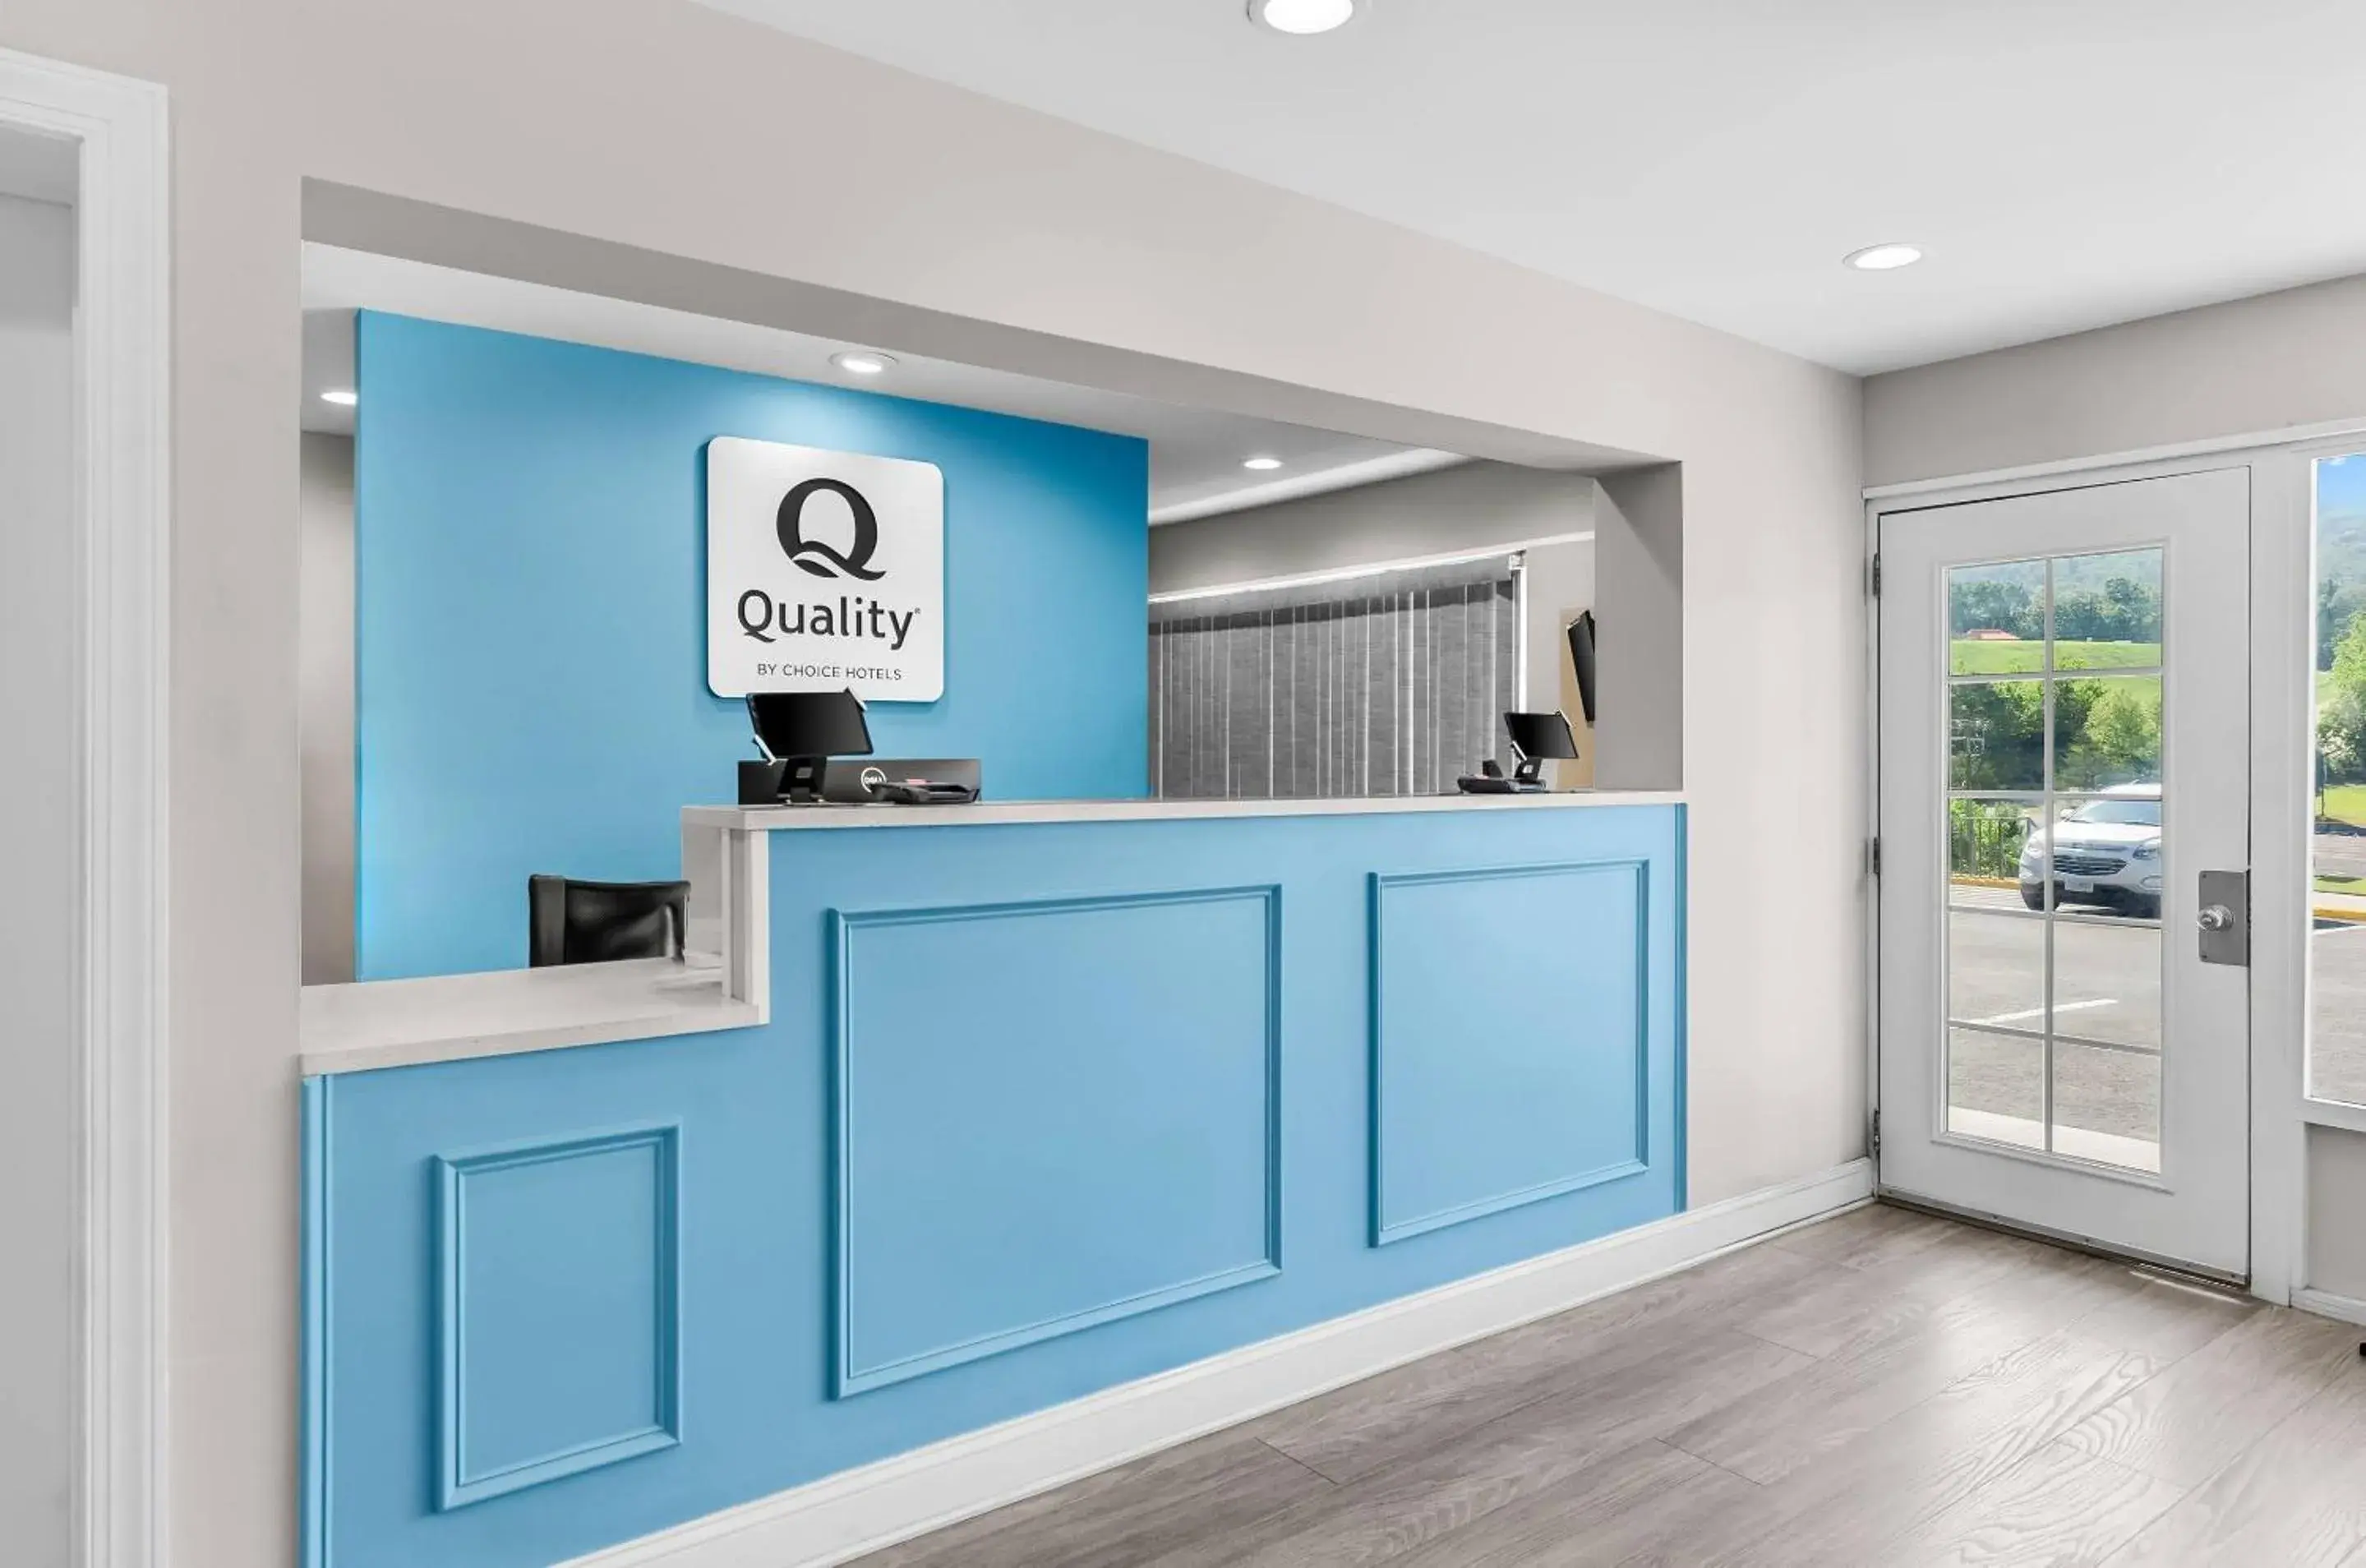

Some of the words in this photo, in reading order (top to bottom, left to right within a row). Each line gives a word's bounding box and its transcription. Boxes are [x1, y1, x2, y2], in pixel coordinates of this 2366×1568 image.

[776, 477, 887, 581] Q
[737, 589, 914, 651] Quality
[757, 663, 777, 676] BY
[782, 664, 840, 678] CHOICE
[846, 667, 902, 680] HOTELS
